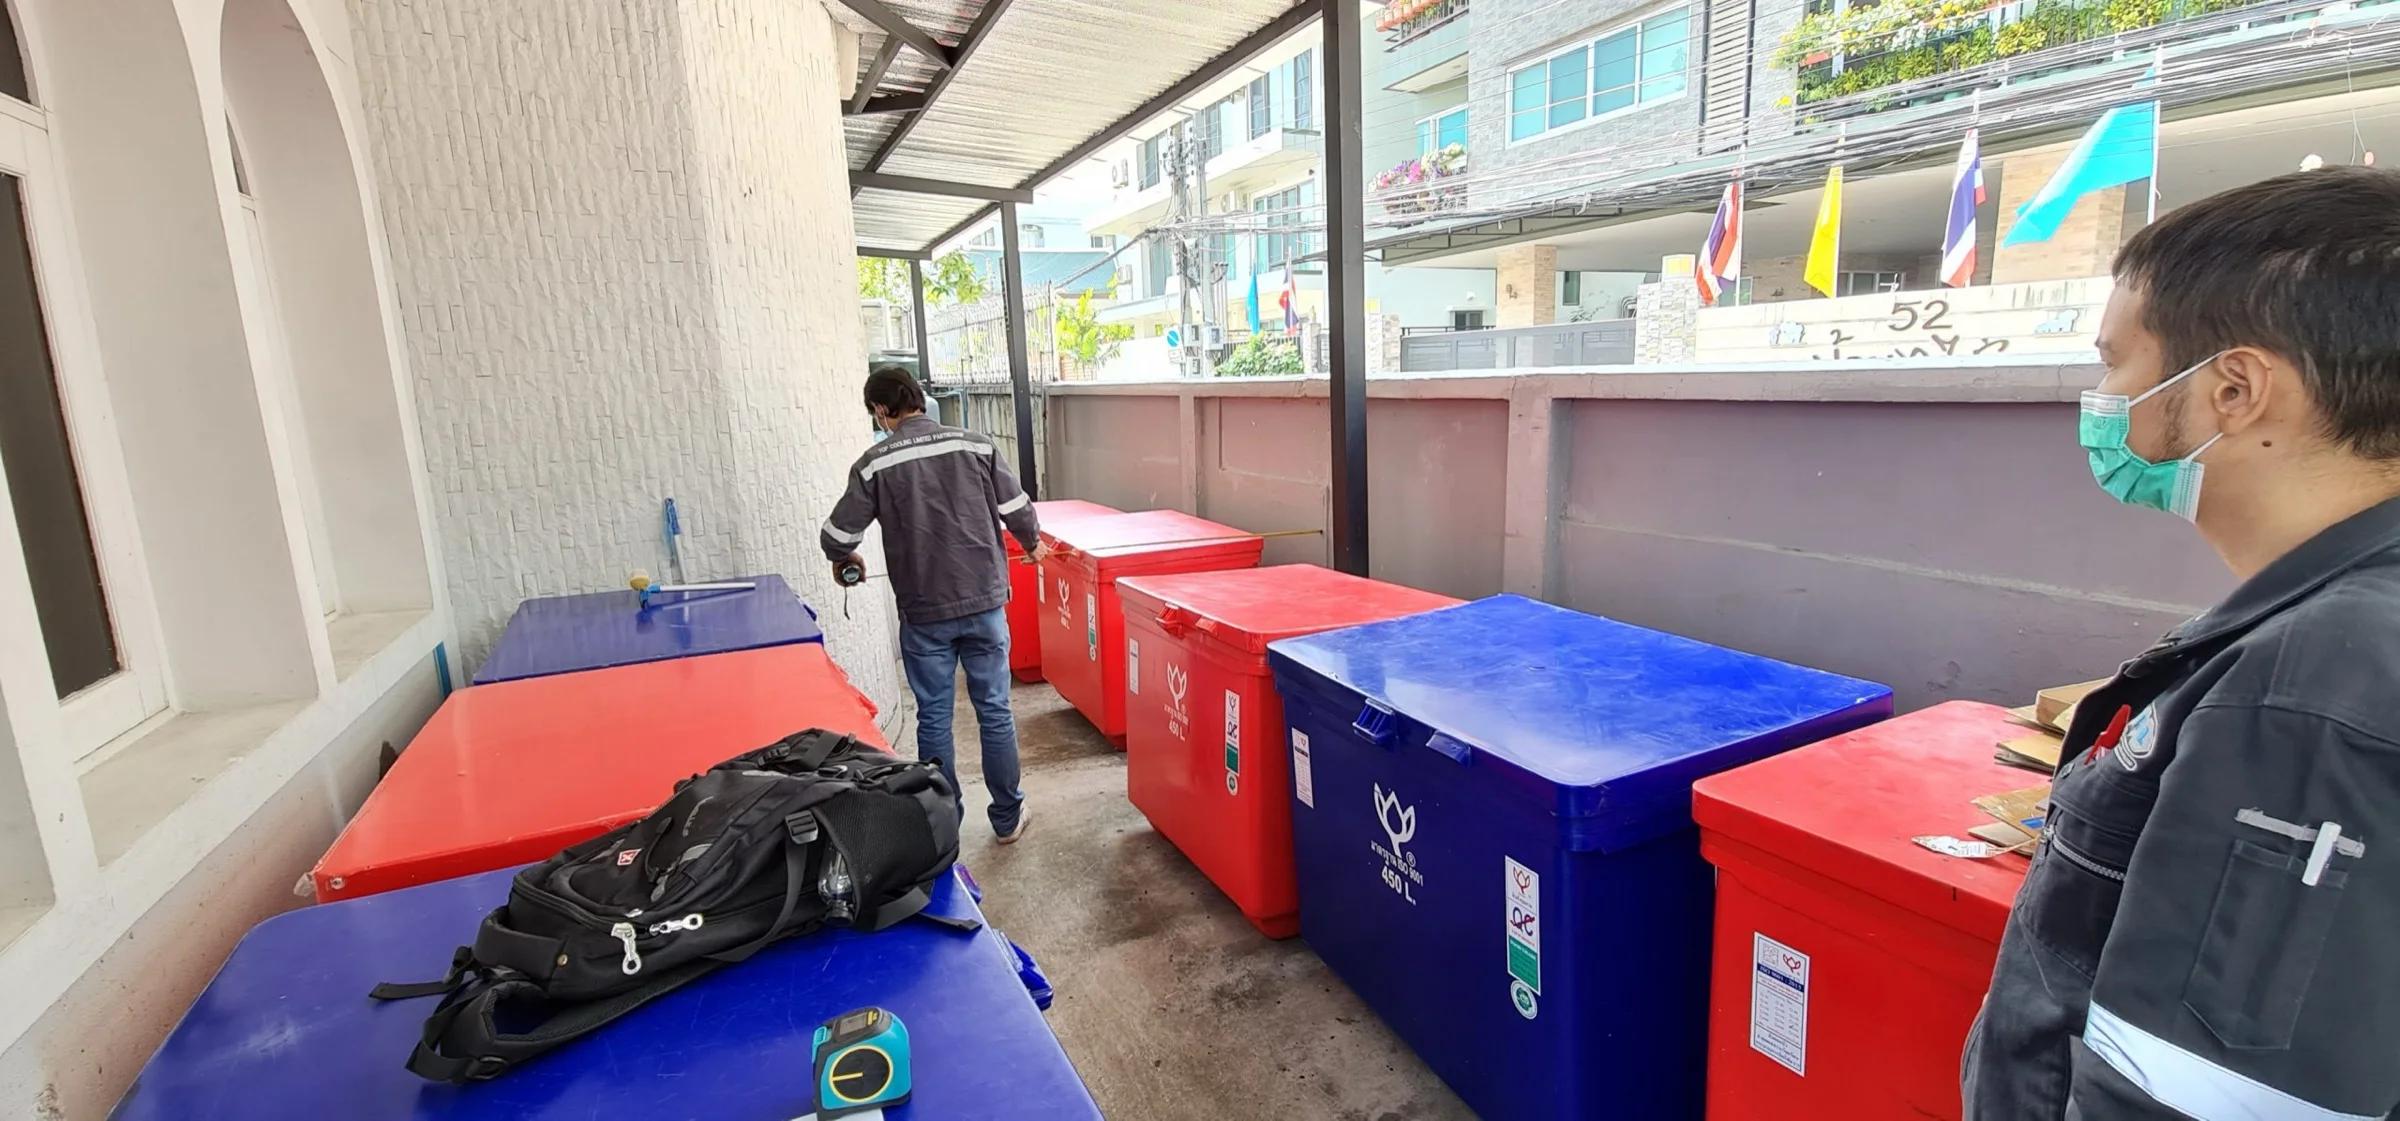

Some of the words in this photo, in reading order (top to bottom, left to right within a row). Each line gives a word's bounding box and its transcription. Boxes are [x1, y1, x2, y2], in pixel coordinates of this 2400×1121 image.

[1888, 299, 1953, 331] 52
[1397, 858, 1408, 875] ISO
[1381, 865, 1403, 895] 450
[1404, 881, 1417, 906] L.
